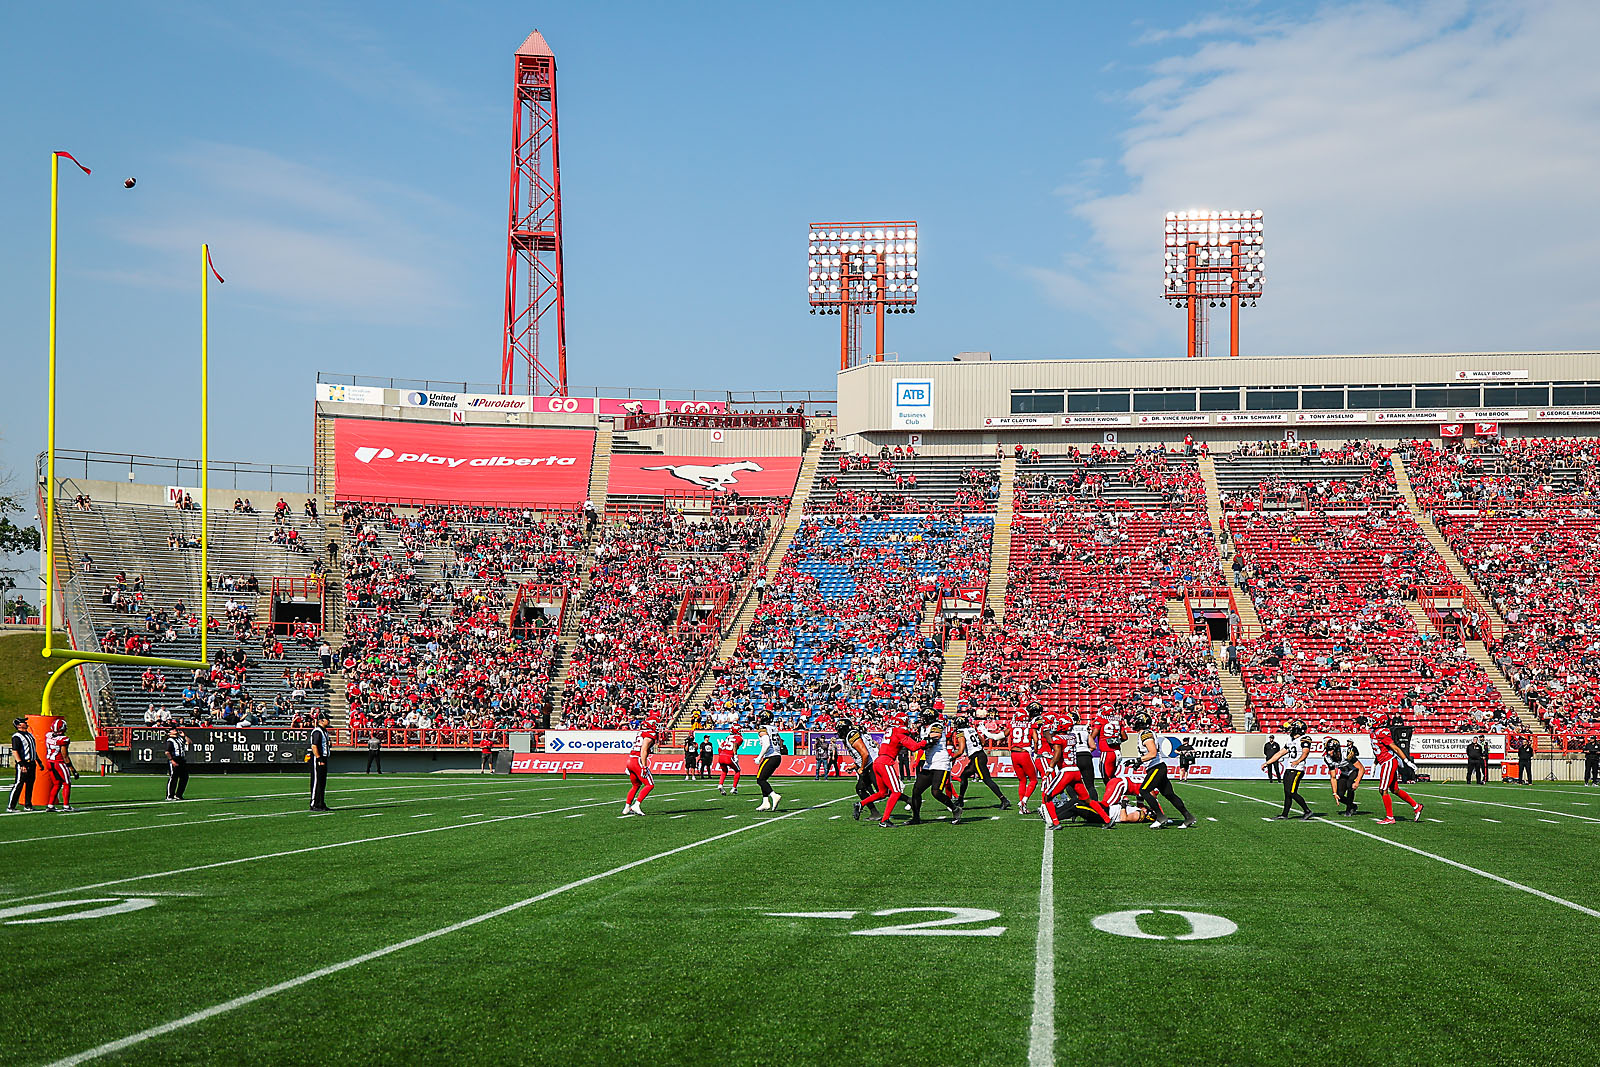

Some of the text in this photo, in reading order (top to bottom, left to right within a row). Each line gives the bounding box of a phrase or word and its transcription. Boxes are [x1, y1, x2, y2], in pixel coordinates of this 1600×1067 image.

[429, 393, 457, 402] United
[903, 389, 925, 400] ATB
[428, 400, 459, 408] Rentals
[478, 398, 526, 409] Purolator
[548, 398, 578, 412] GO
[453, 411, 462, 421] N
[713, 431, 721, 440] O
[911, 435, 919, 444] P
[1106, 433, 1115, 442] Q
[1286, 430, 1295, 441] R
[396, 453, 577, 467] play alberta
[170, 488, 183, 501] M
[132, 729, 308, 743] STAMP 14:46 TI CATS
[1012, 727, 1031, 744] 91
[233, 743, 261, 752] BALL ON
[568, 739, 633, 751] co-operato
[1188, 736, 1230, 748] United
[193, 744, 202, 752] TO
[204, 744, 215, 752] GO
[265, 744, 279, 752] QTR
[1193, 748, 1233, 759] entals
[138, 748, 153, 762] 10
[204, 751, 212, 762] 3
[243, 751, 255, 762] 18
[267, 751, 275, 762] 2
[511, 759, 531, 770] ed
[652, 760, 684, 771] red
